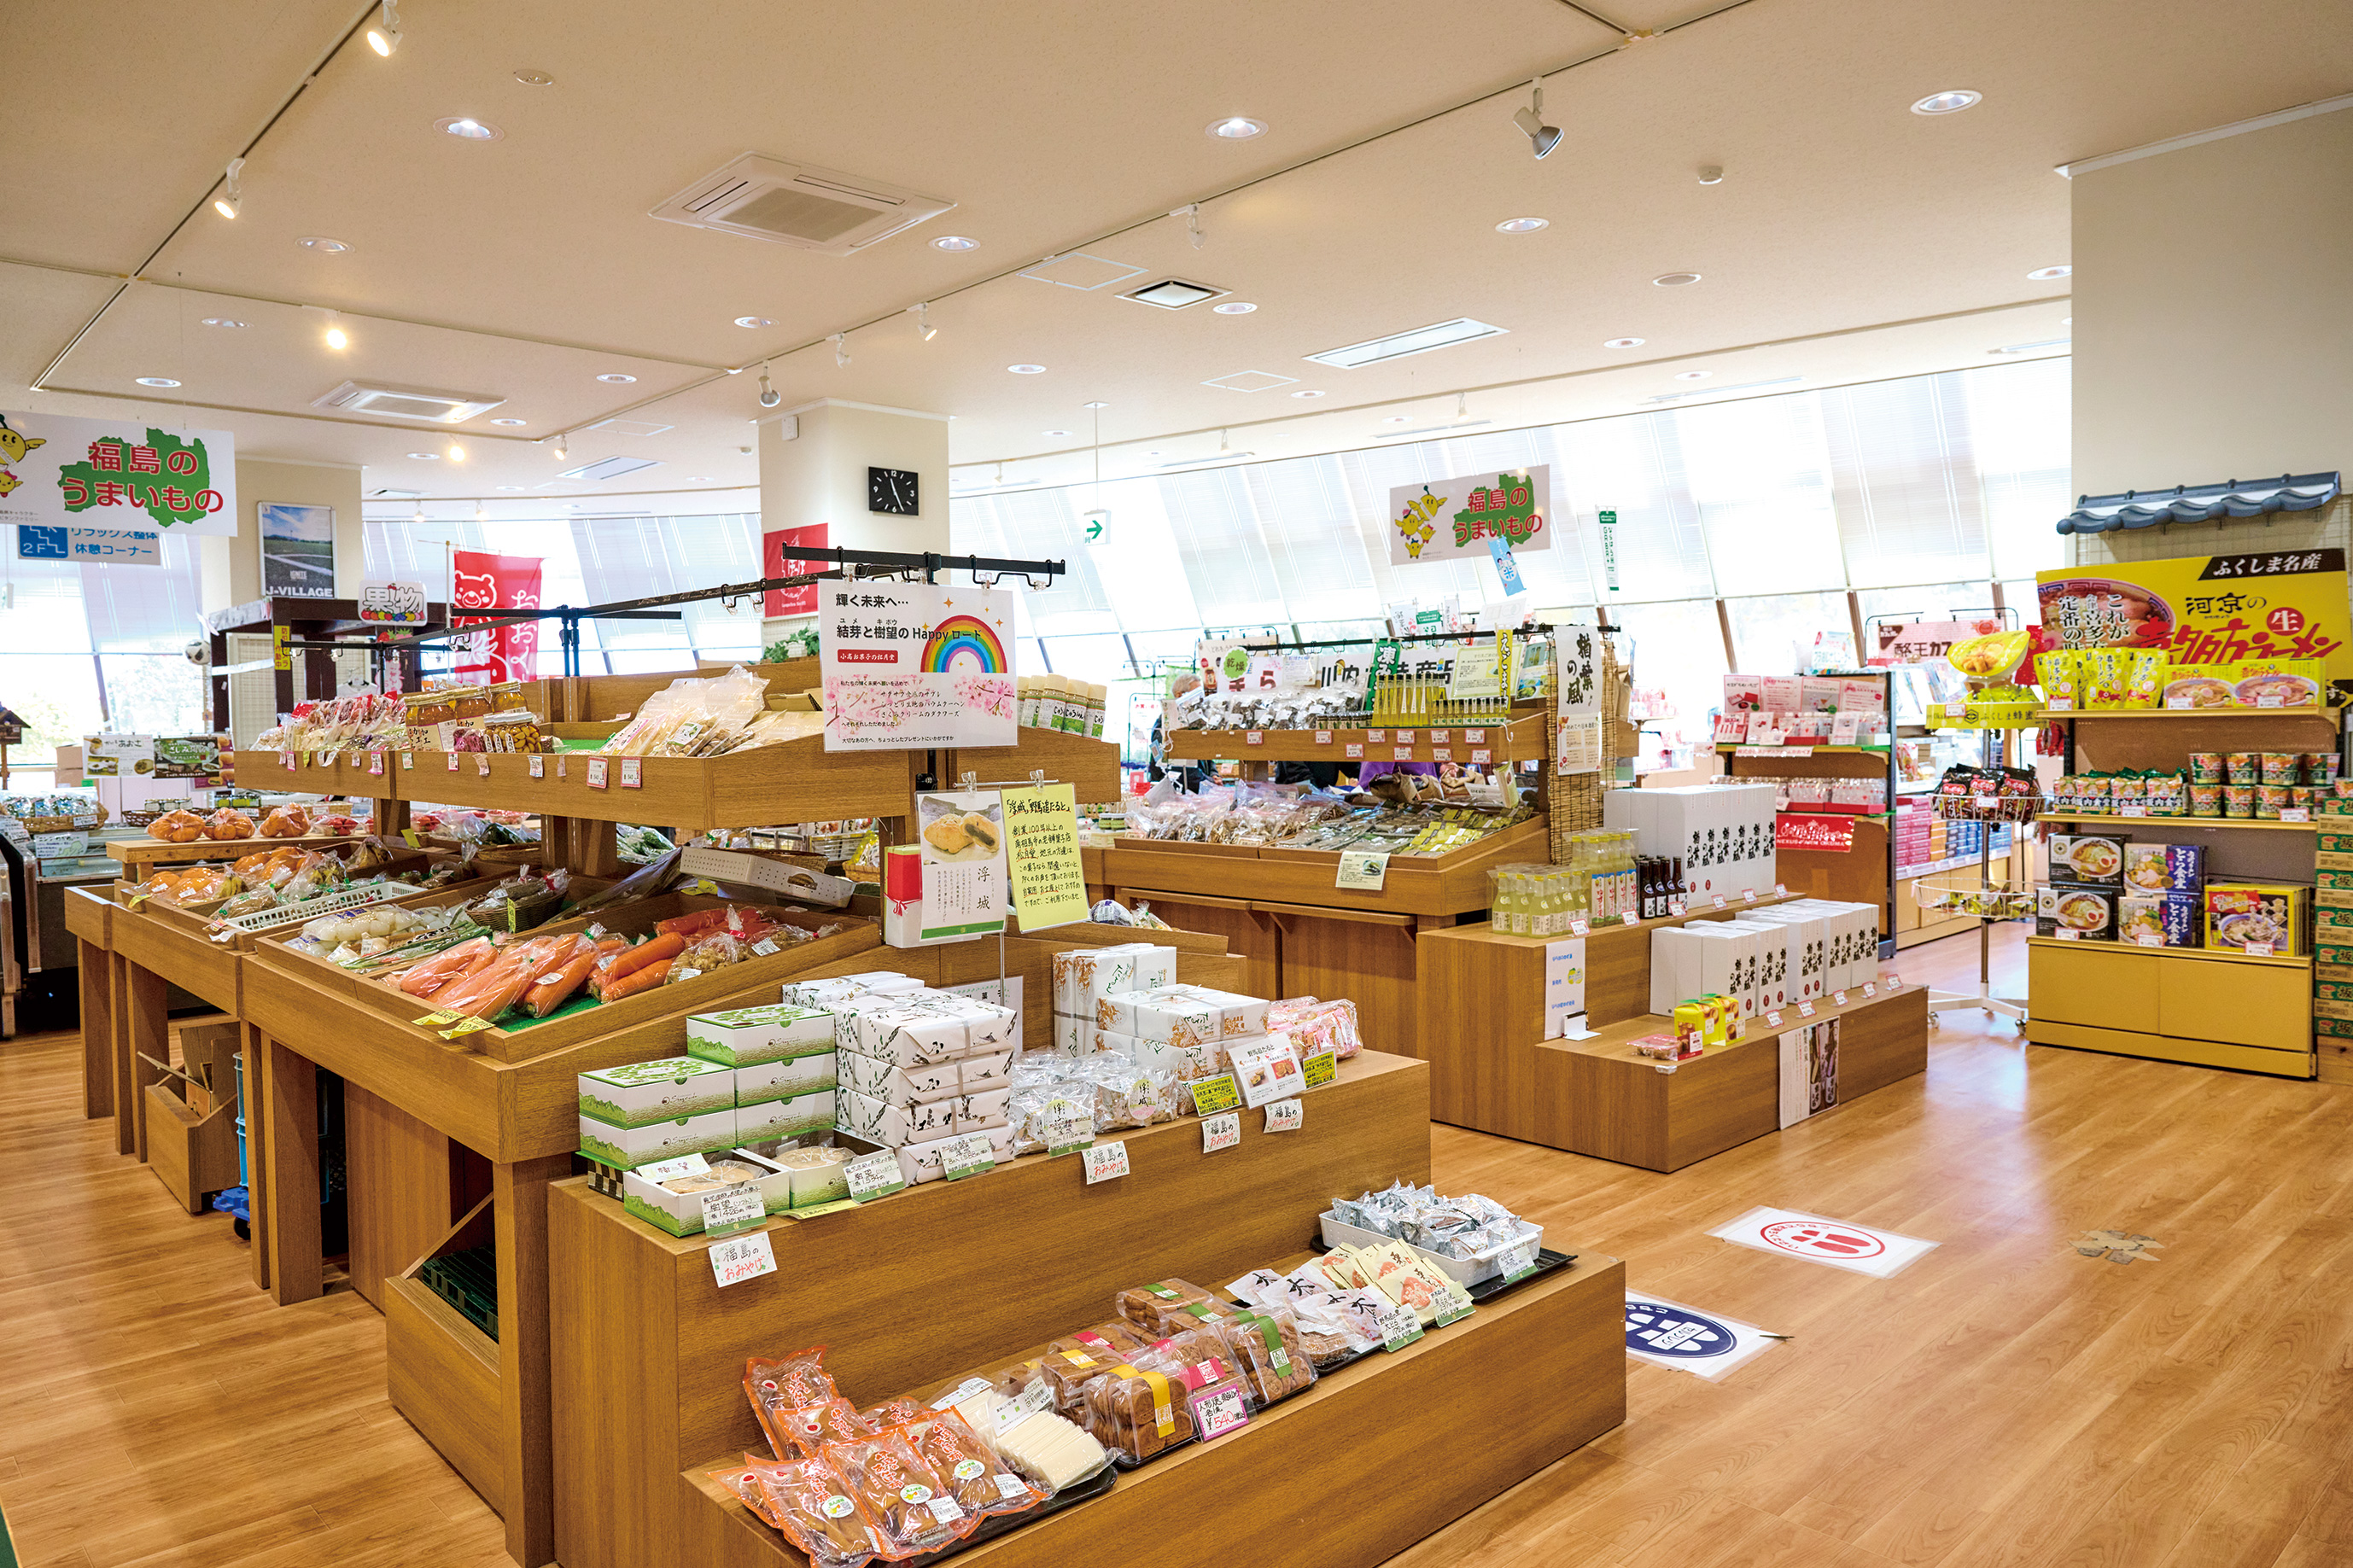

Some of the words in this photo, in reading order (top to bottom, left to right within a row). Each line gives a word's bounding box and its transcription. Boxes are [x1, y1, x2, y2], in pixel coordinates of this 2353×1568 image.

[89, 441, 197, 475] 福島の
[62, 478, 224, 512] うまいもの
[1468, 487, 1527, 513] 福島の
[1454, 514, 1543, 543] うまいもの
[75, 541, 153, 557] 休憩コーナー
[2214, 553, 2322, 577] ふくしま名産
[266, 586, 333, 597] J-VILLAGE
[363, 586, 423, 614] 果物
[2272, 609, 2299, 633] 生
[837, 625, 909, 639] 結芽と樹望の
[913, 627, 949, 641] Happy
[952, 629, 982, 641] ロード
[977, 866, 990, 910] 浮城
[1247, 1044, 1276, 1058] 野馬追たると
[1275, 1106, 1298, 1118] 福島の
[1211, 1121, 1234, 1135] 福島の
[1272, 1116, 1299, 1128] おみやげ
[1210, 1130, 1235, 1148] おみやげ
[1094, 1147, 1124, 1165] 福島の
[1094, 1158, 1126, 1176] おみやげ
[724, 1243, 759, 1262] 福島の
[724, 1255, 766, 1280] おみやげ
